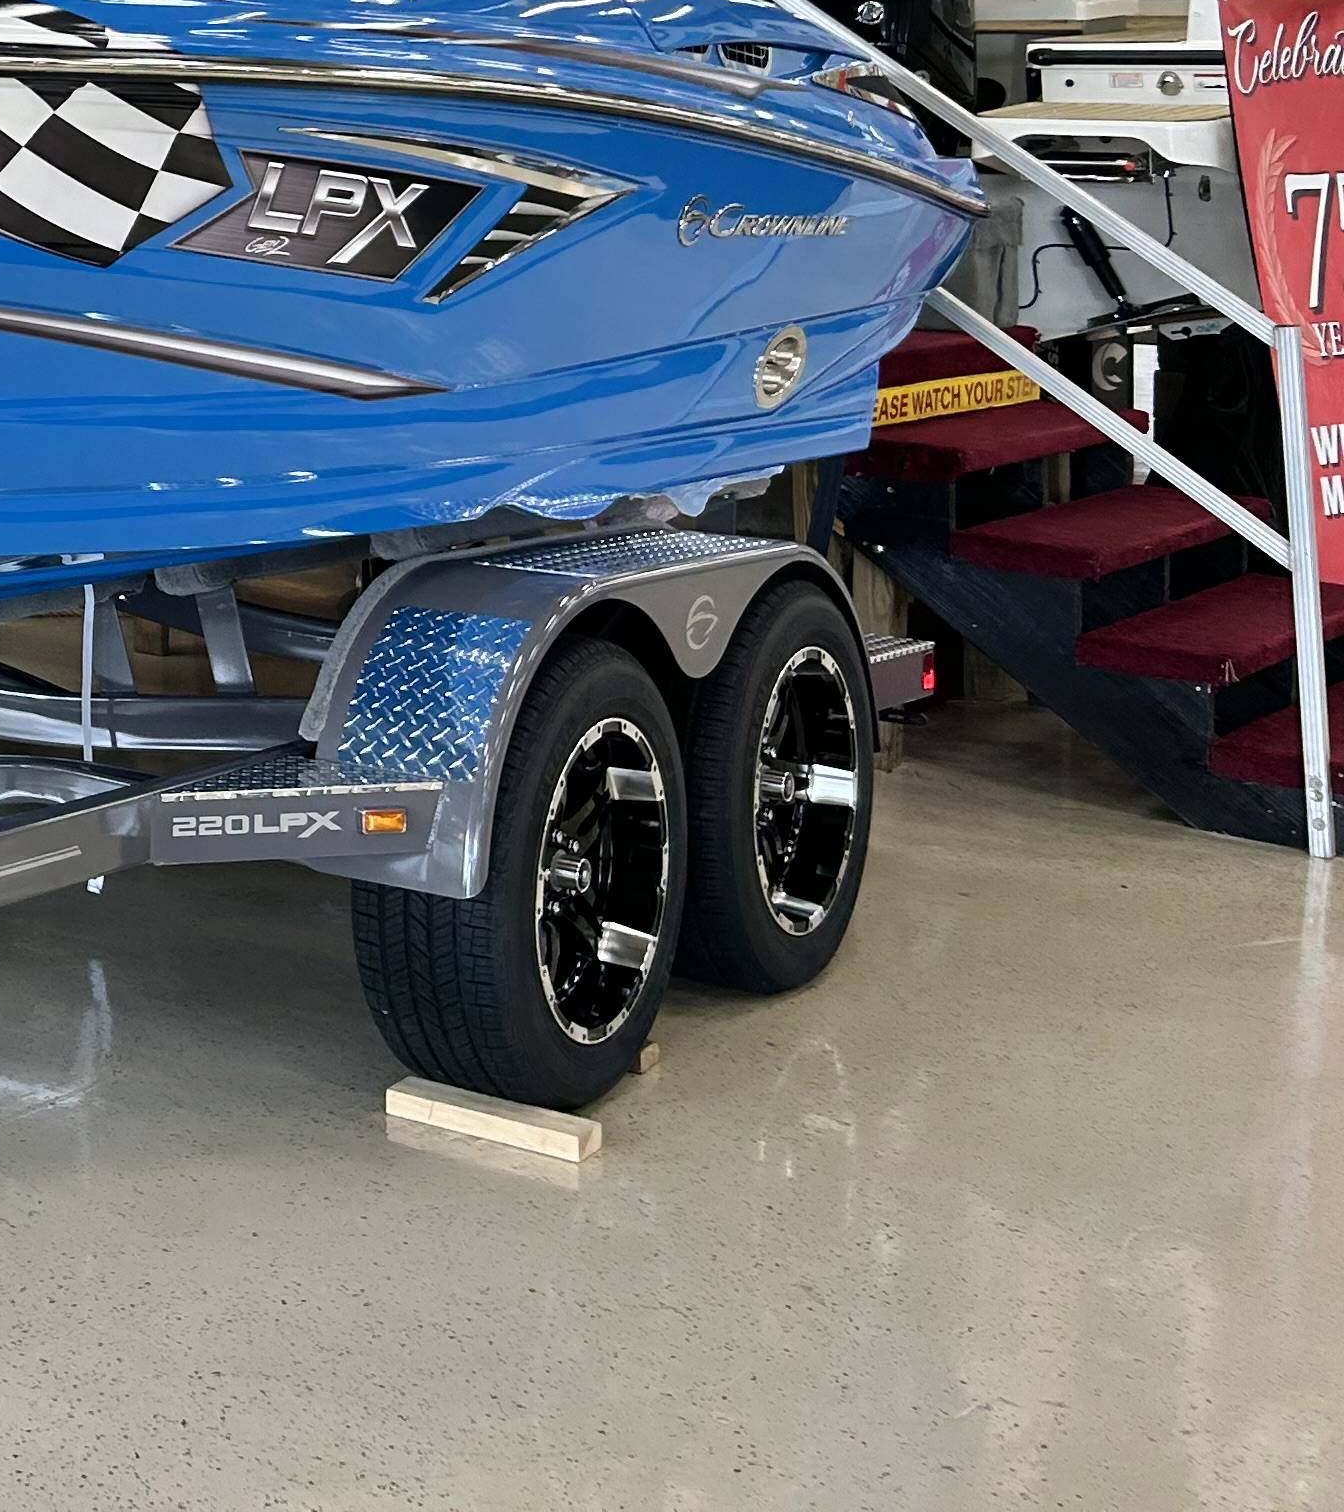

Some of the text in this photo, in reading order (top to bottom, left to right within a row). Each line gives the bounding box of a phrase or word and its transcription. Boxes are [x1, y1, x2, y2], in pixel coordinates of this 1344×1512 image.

[1227, 11, 1344, 95] Celebra
[248, 161, 430, 264] LPX
[709, 202, 852, 238] CROWNLINE
[1284, 173, 1344, 312] 7
[1313, 320, 1344, 359] YE
[912, 381, 961, 416] WATCH
[965, 377, 1004, 405] YOUR
[172, 810, 343, 839] 220LPX
